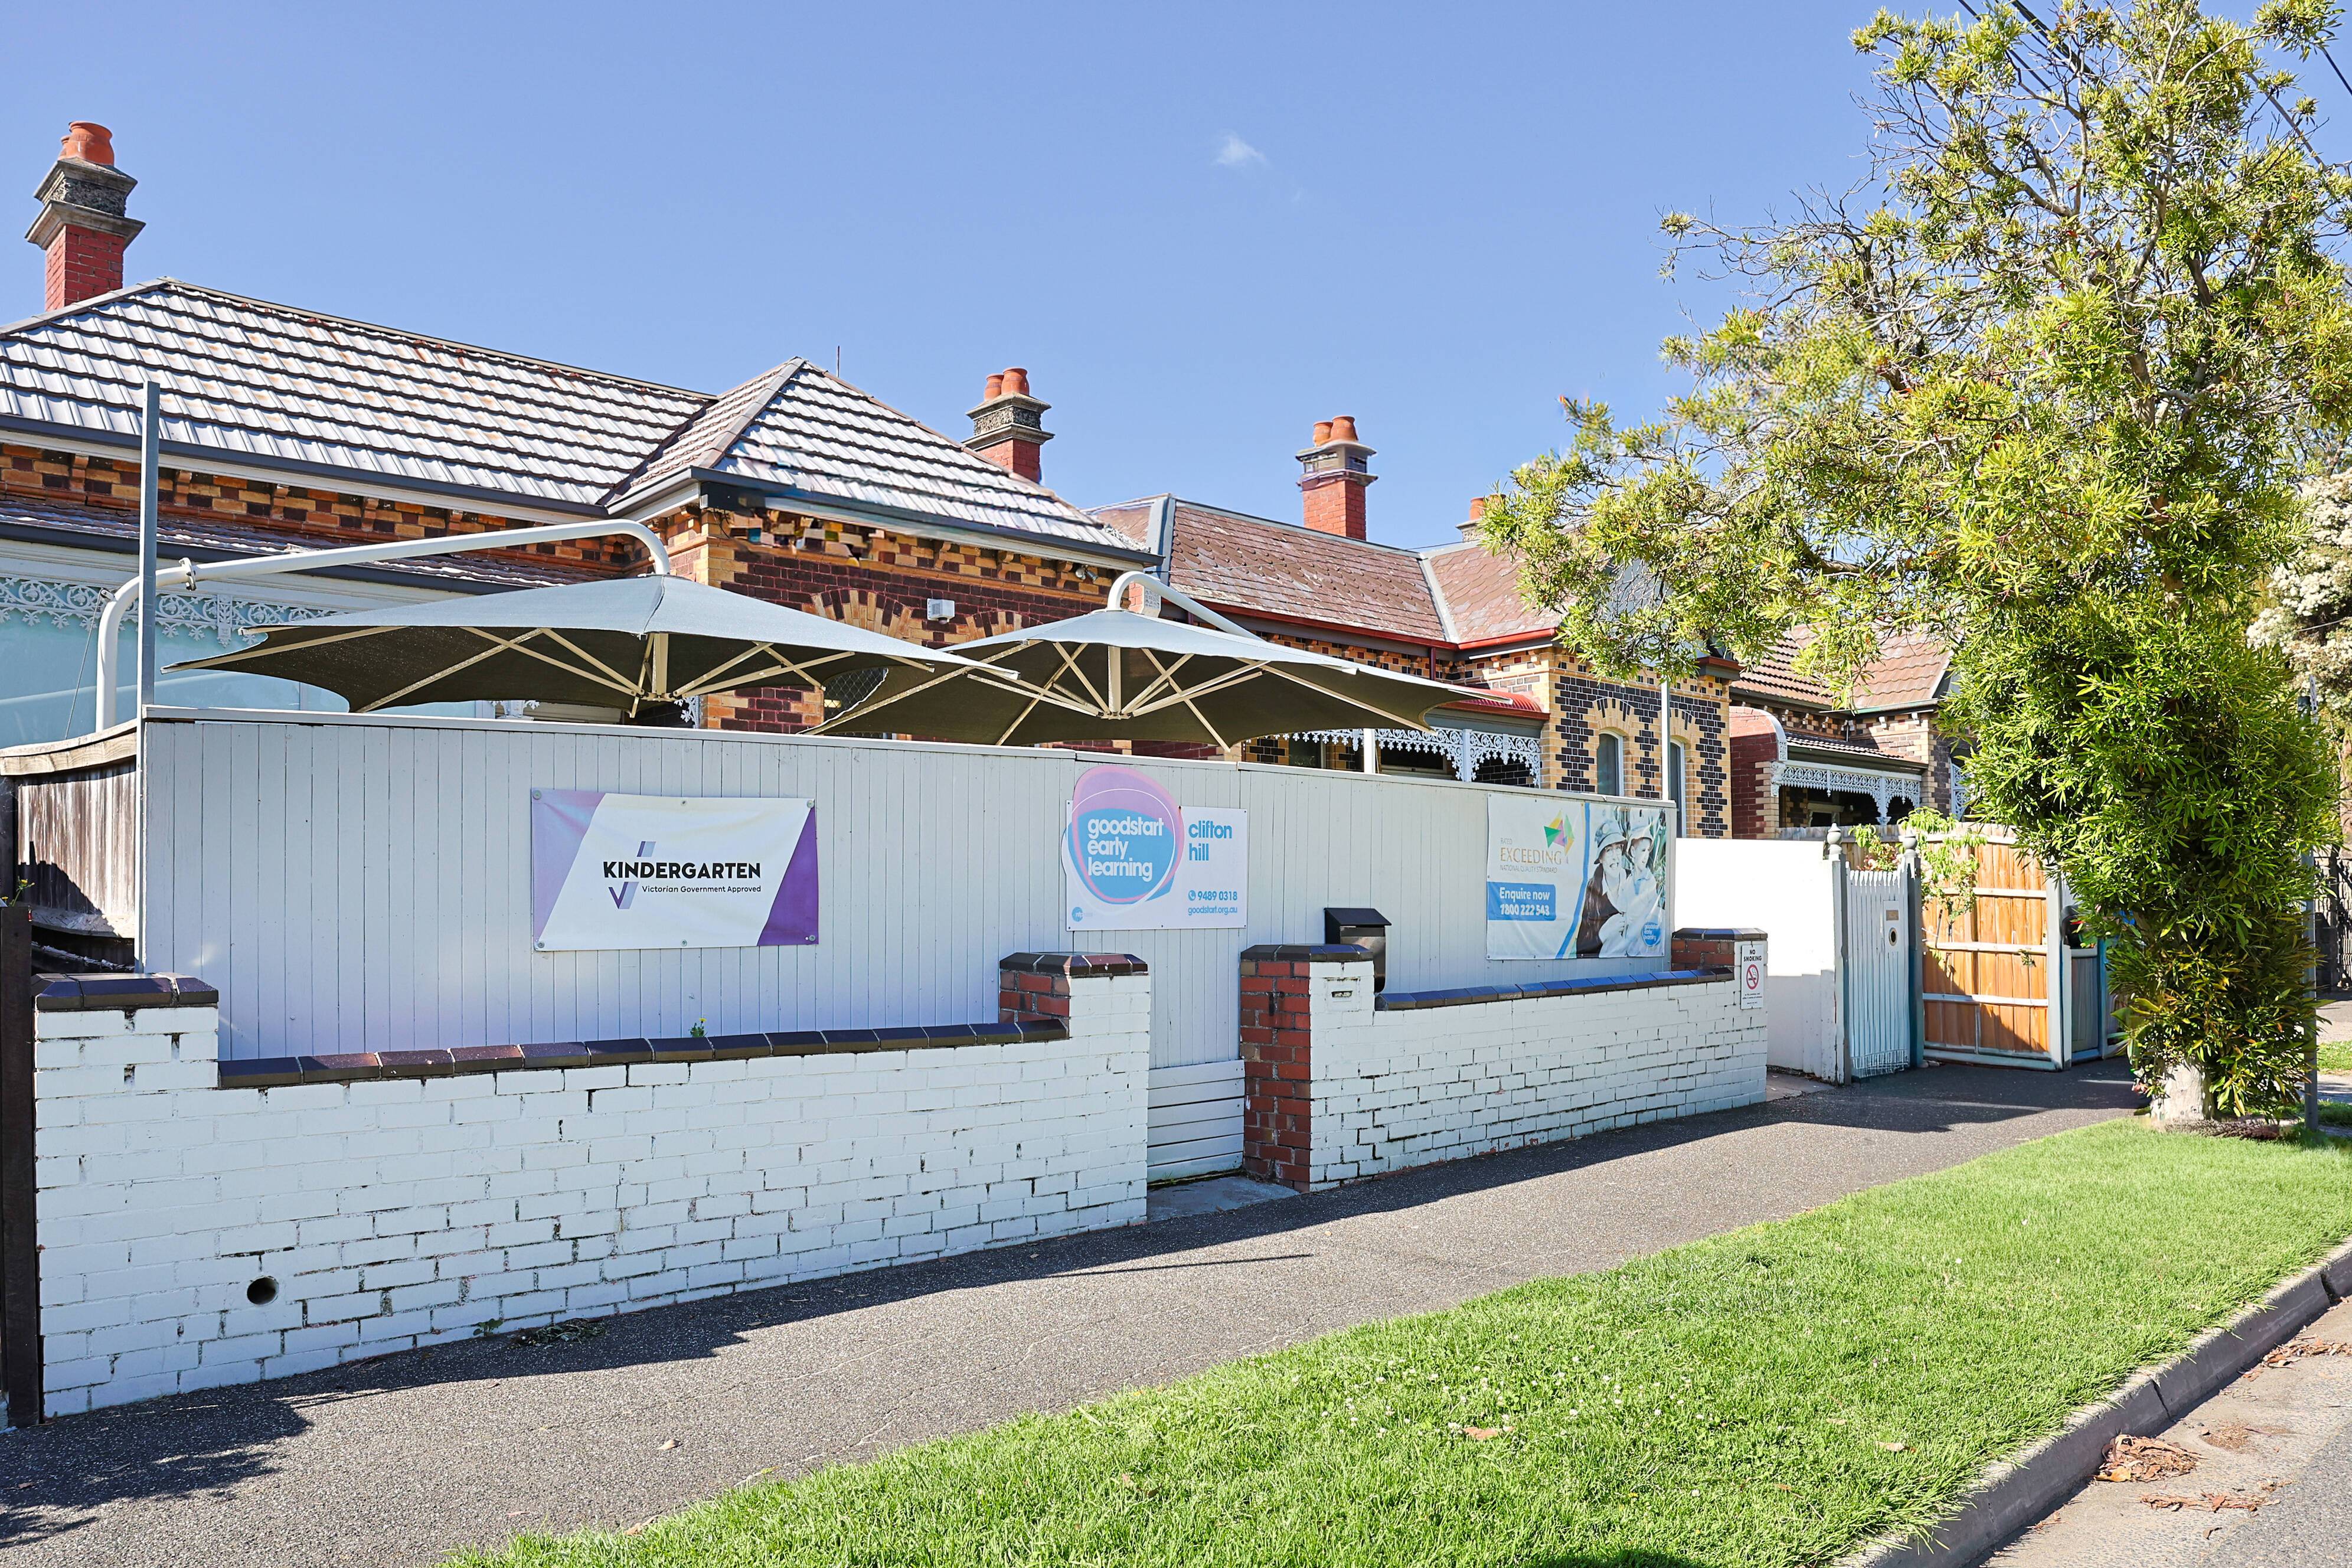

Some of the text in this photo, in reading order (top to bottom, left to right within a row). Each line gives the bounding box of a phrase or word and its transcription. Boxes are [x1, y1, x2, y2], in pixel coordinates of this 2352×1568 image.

[1087, 816, 1164, 838] goodstart
[1188, 820, 1232, 838] clifton
[1087, 837, 1128, 860] early
[1188, 843, 1209, 861] hill
[1501, 847, 1562, 865] EXCEEDING
[603, 861, 761, 878] KINDERGARTEN
[1088, 857, 1152, 882] learning
[727, 885, 761, 894] Approved
[1198, 891, 1237, 901] 9489 0318
[1500, 887, 1550, 902] Enquire now
[1188, 906, 1238, 916] goodstart.org.au
[1500, 904, 1550, 916] 1800 222 543
